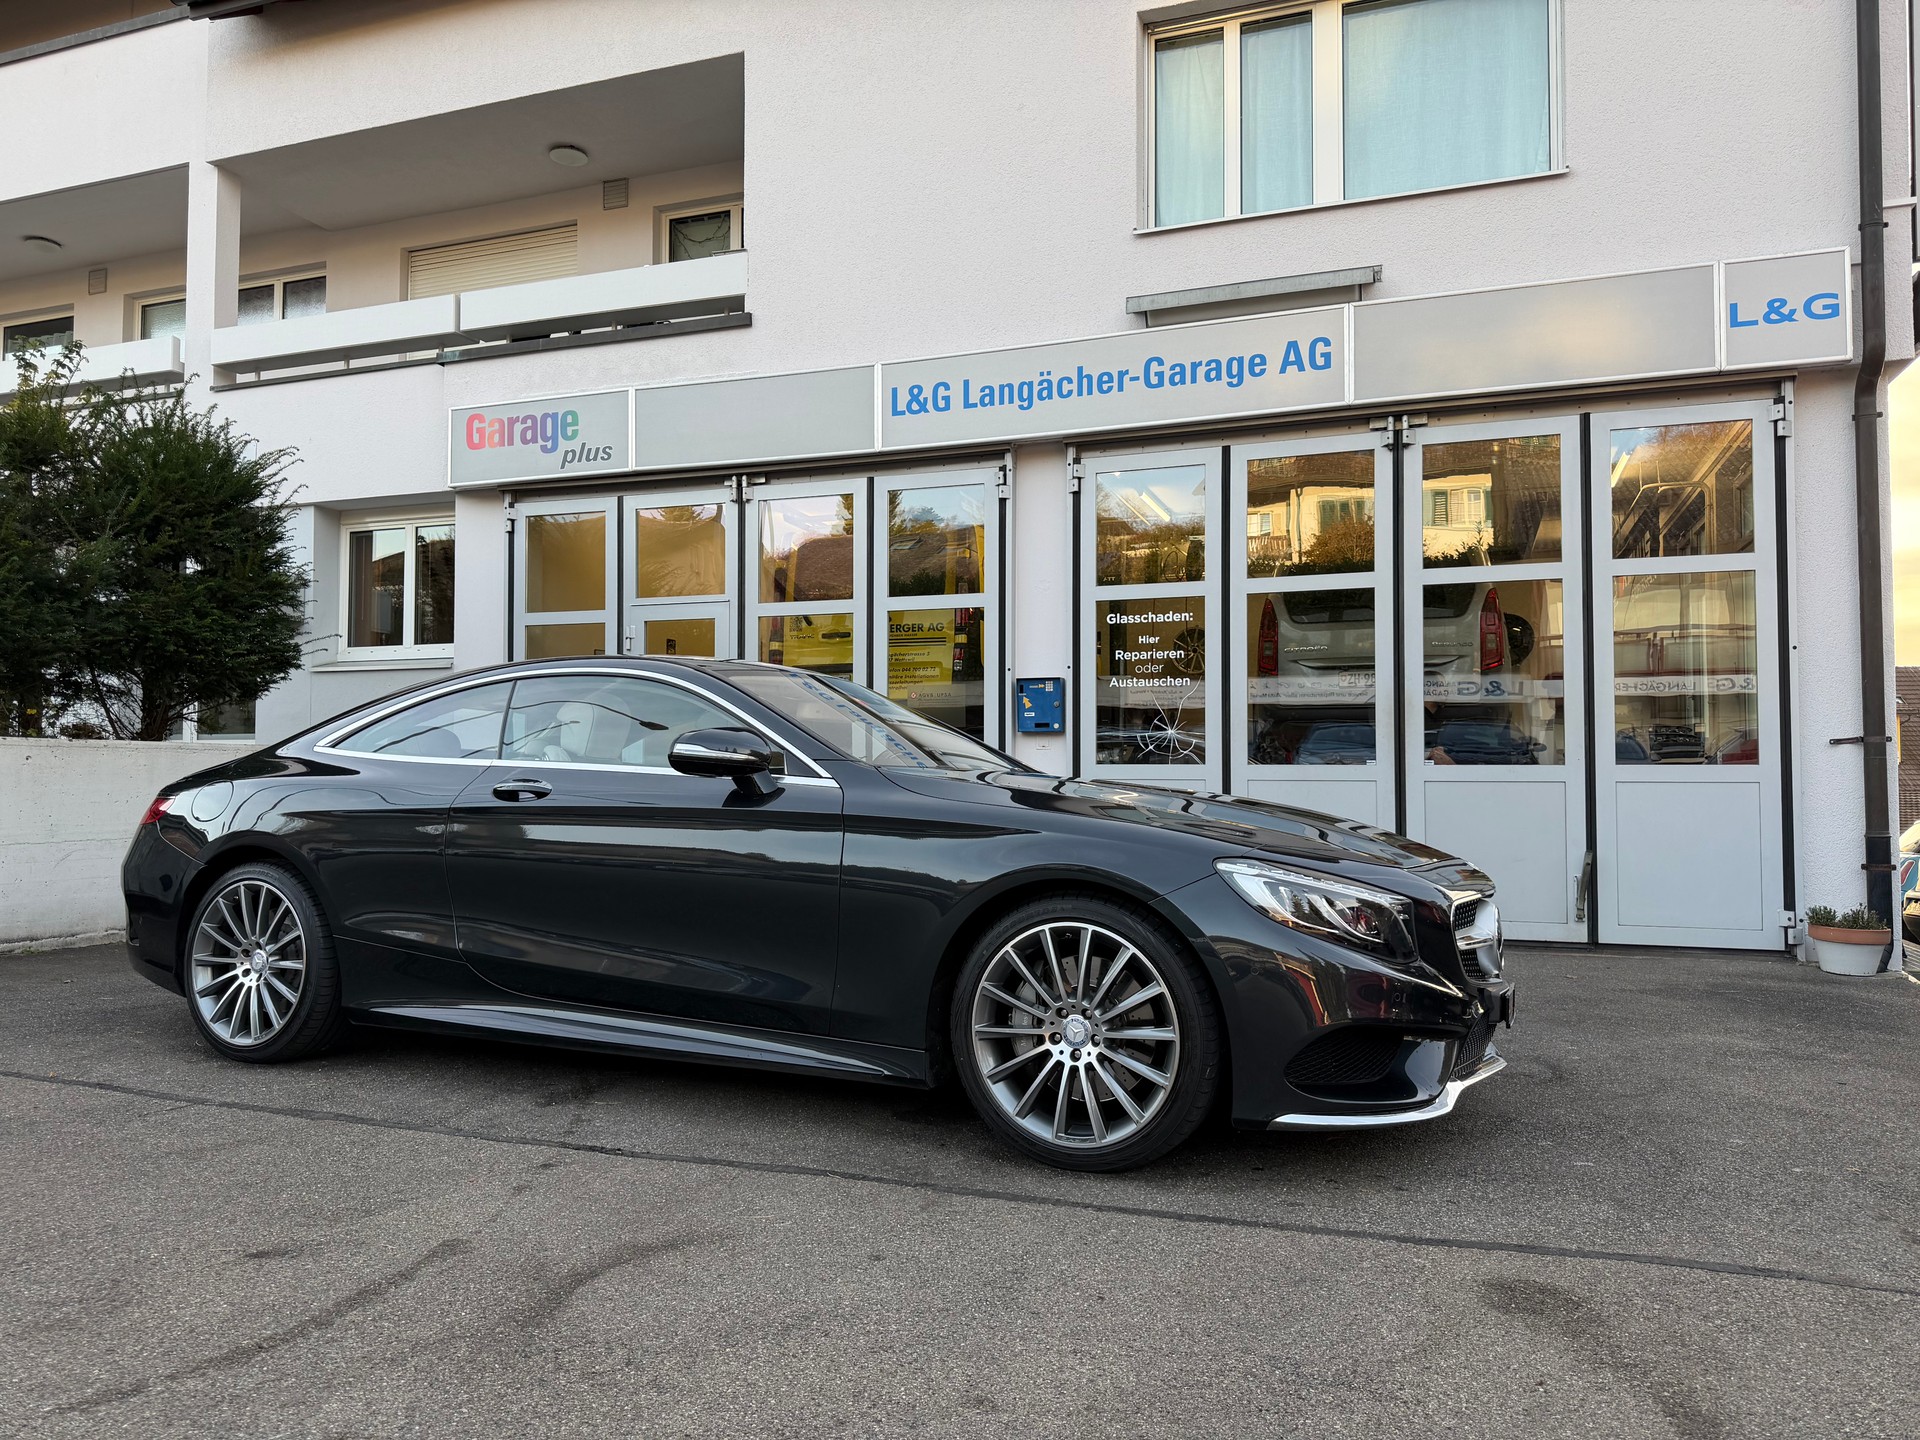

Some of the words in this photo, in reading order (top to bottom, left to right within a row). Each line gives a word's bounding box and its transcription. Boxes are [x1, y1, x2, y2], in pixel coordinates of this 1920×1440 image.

[1729, 292, 1840, 329] L&G
[890, 381, 951, 417] L&G
[962, 350, 1268, 411] Langächer-Garage
[1278, 336, 1333, 375] AG
[465, 409, 580, 455] Garage
[559, 441, 614, 470] plus
[1106, 611, 1194, 625] Glasschaden:
[889, 623, 925, 633] ERGER
[927, 622, 945, 632] AG
[1138, 634, 1160, 644] Hier
[1115, 649, 1185, 661] Reparieren
[1134, 662, 1164, 673] oder
[1109, 675, 1191, 688] Austauschen
